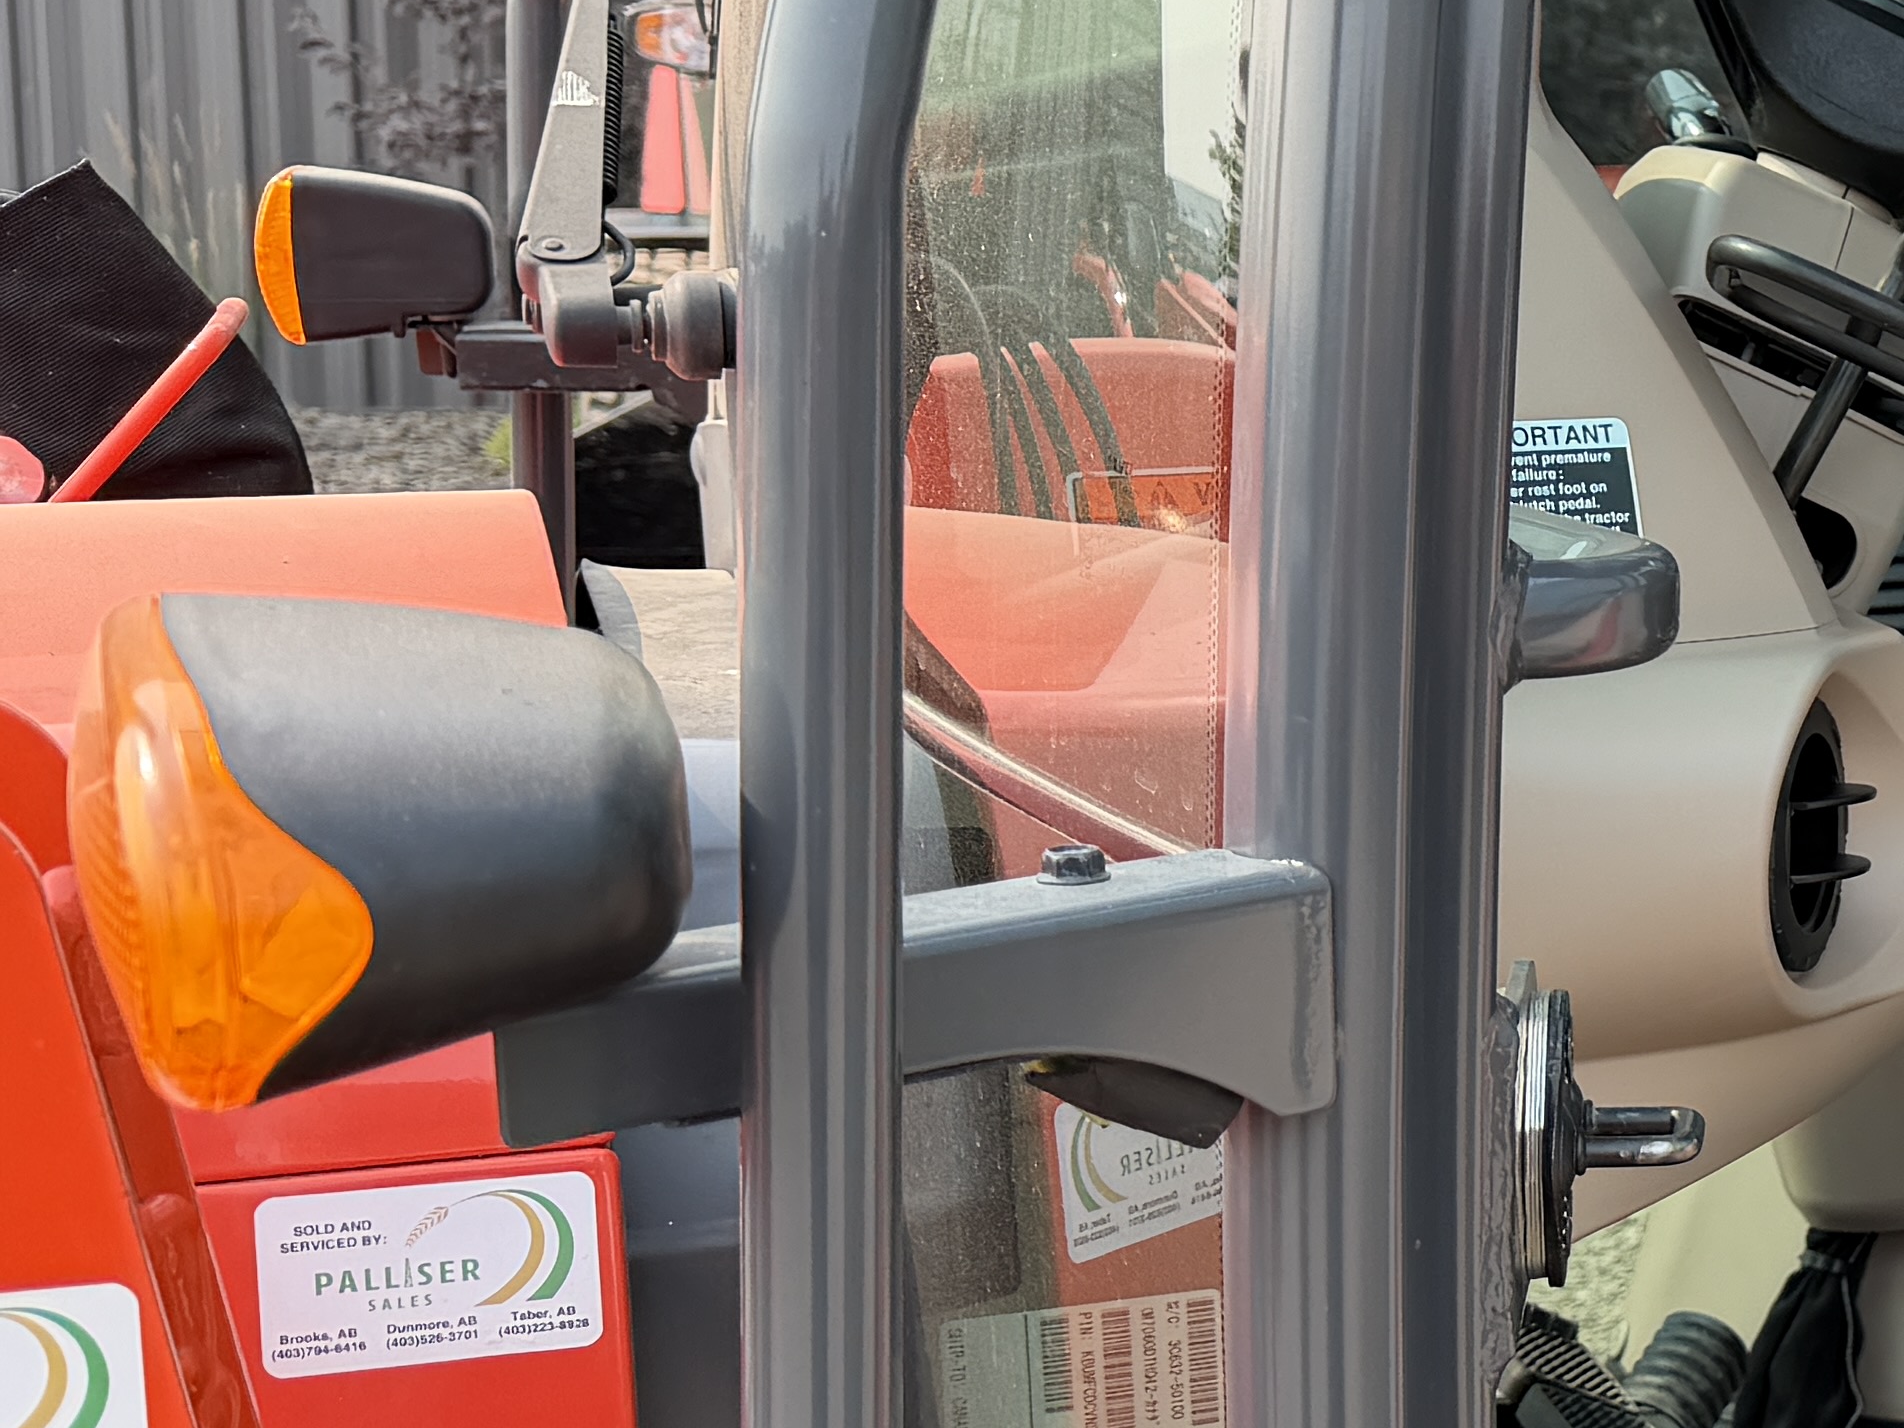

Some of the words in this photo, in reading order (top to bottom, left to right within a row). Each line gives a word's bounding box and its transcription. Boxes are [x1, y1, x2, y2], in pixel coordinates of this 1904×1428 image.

[1512, 423, 1613, 447] ORTANT
[1541, 450, 1611, 469] premature
[1527, 483, 1555, 496] rest
[1558, 482, 1587, 495] foot
[1590, 482, 1607, 494] on
[1558, 496, 1601, 512] pedal.
[293, 1224, 335, 1237] SOLD
[339, 1219, 372, 1234] AND
[280, 1238, 357, 1254] SERVICED
[362, 1234, 388, 1249] BY:
[314, 1257, 481, 1296] PALLISER
[367, 1293, 434, 1312] SALES
[556, 1305, 576, 1317] AB
[387, 1319, 454, 1335] Dunmore,
[457, 1316, 478, 1327] AB
[279, 1331, 333, 1346] Brooks,
[338, 1328, 358, 1339] AB
